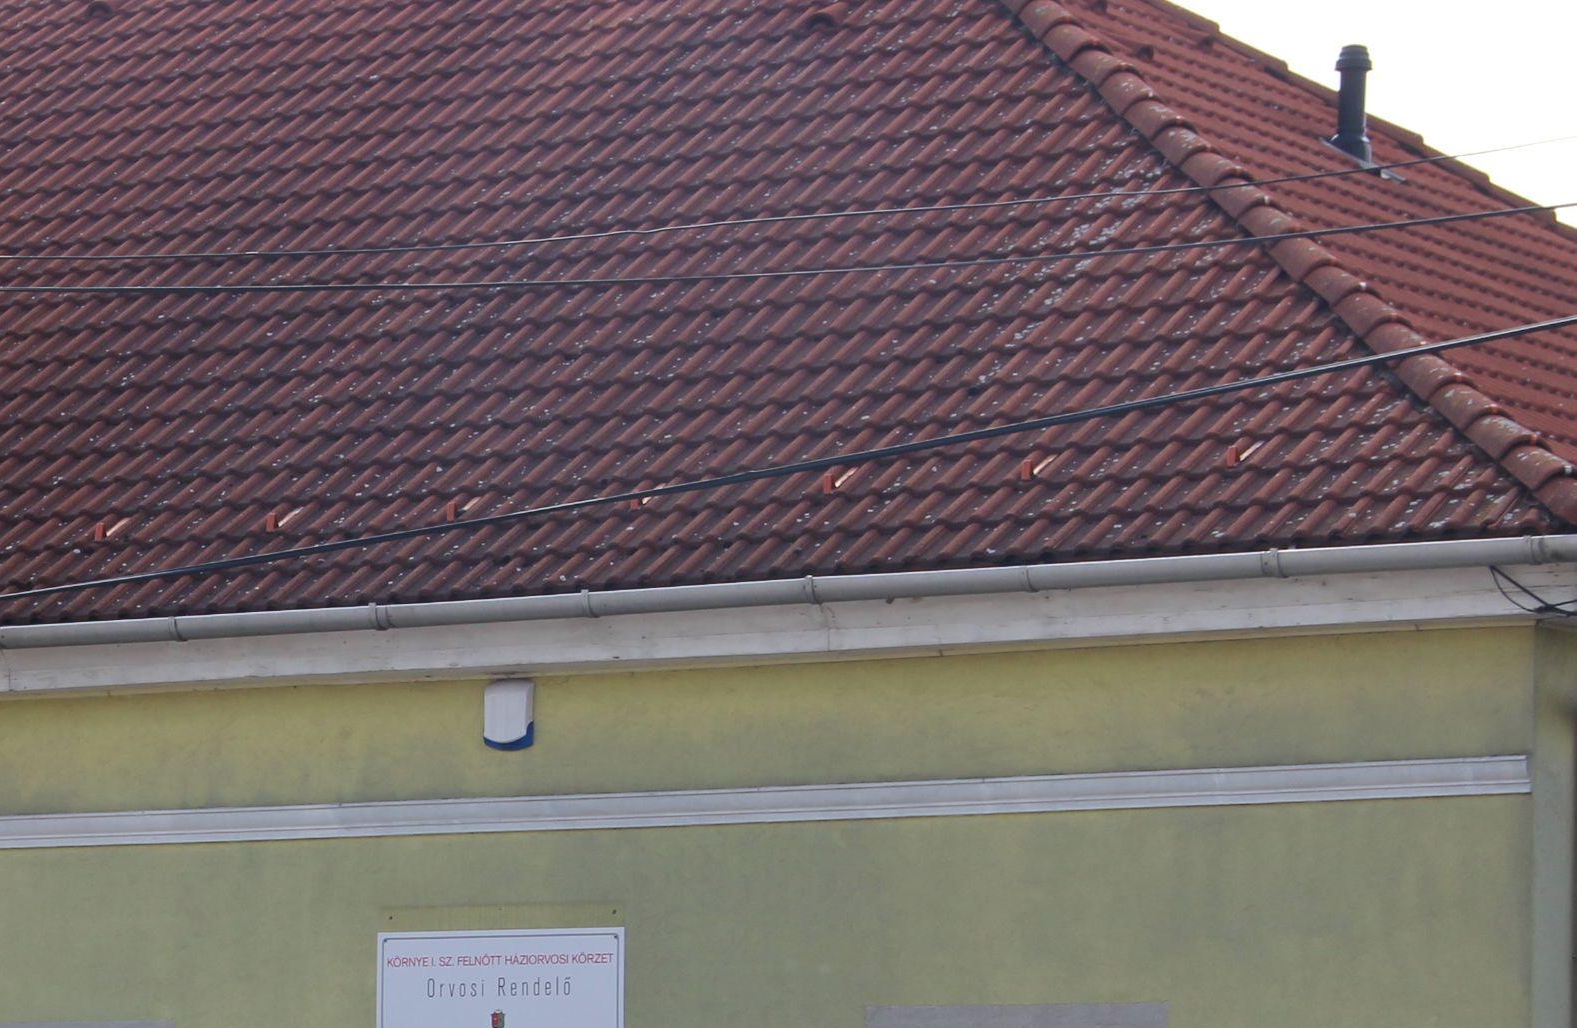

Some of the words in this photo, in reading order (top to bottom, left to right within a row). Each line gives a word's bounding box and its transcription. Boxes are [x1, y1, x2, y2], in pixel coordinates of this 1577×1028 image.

[387, 956, 429, 968] KÖRNYE
[439, 956, 453, 967] SZ.
[457, 953, 502, 967] FELNŐTT
[505, 953, 569, 966] HÁZIORVOSI
[572, 952, 614, 965] KÖRZET
[426, 977, 486, 999] Orvosi
[497, 975, 572, 997] Rendelő
